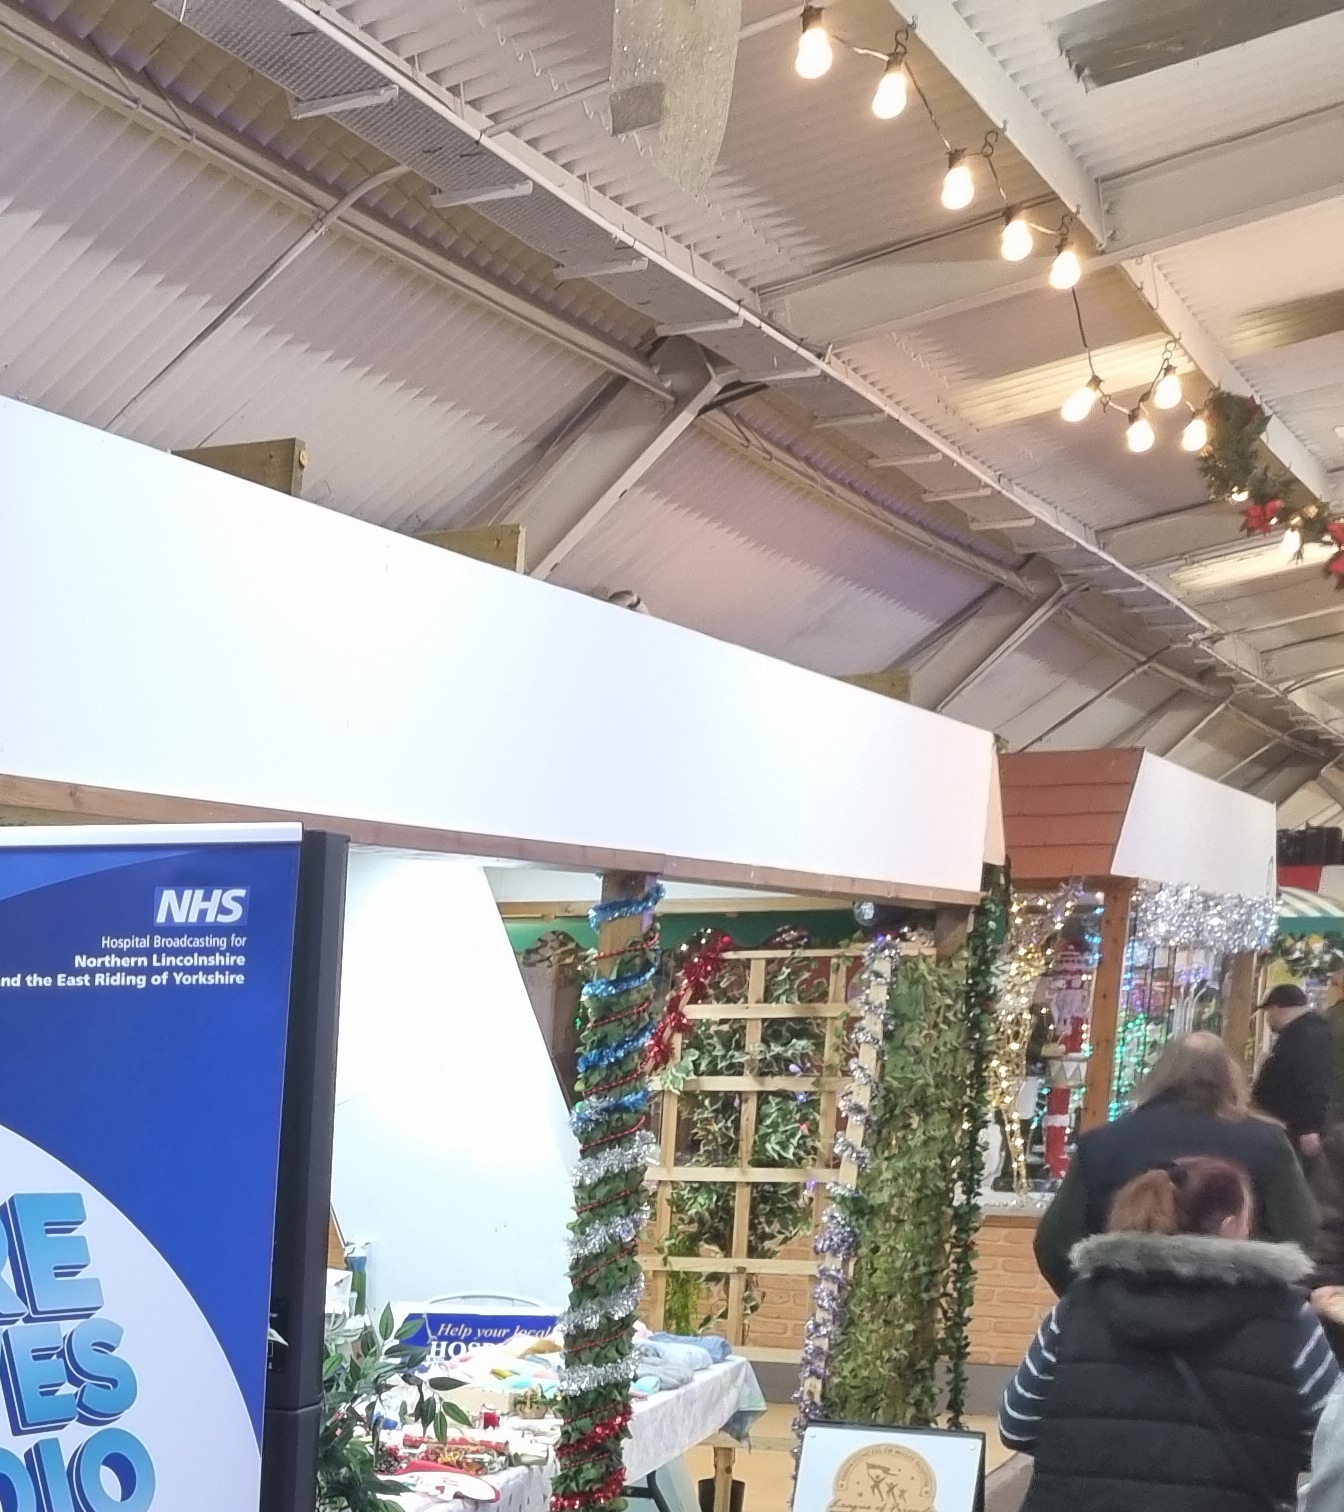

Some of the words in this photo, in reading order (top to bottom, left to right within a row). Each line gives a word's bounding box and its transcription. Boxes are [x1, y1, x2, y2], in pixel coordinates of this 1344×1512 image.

[156, 889, 247, 923] NHS
[101, 935, 150, 951] Hospital
[153, 934, 227, 950] Broadcasting
[230, 933, 247, 948] for
[74, 954, 148, 968] Northern
[152, 952, 246, 967] Lincolnshire
[25, 973, 52, 987] the
[56, 973, 91, 987] East
[94, 972, 146, 989] Riding
[150, 971, 169, 985] of
[172, 970, 245, 985] Yorkshire
[437, 1323, 472, 1338] Help
[474, 1327, 510, 1339] your
